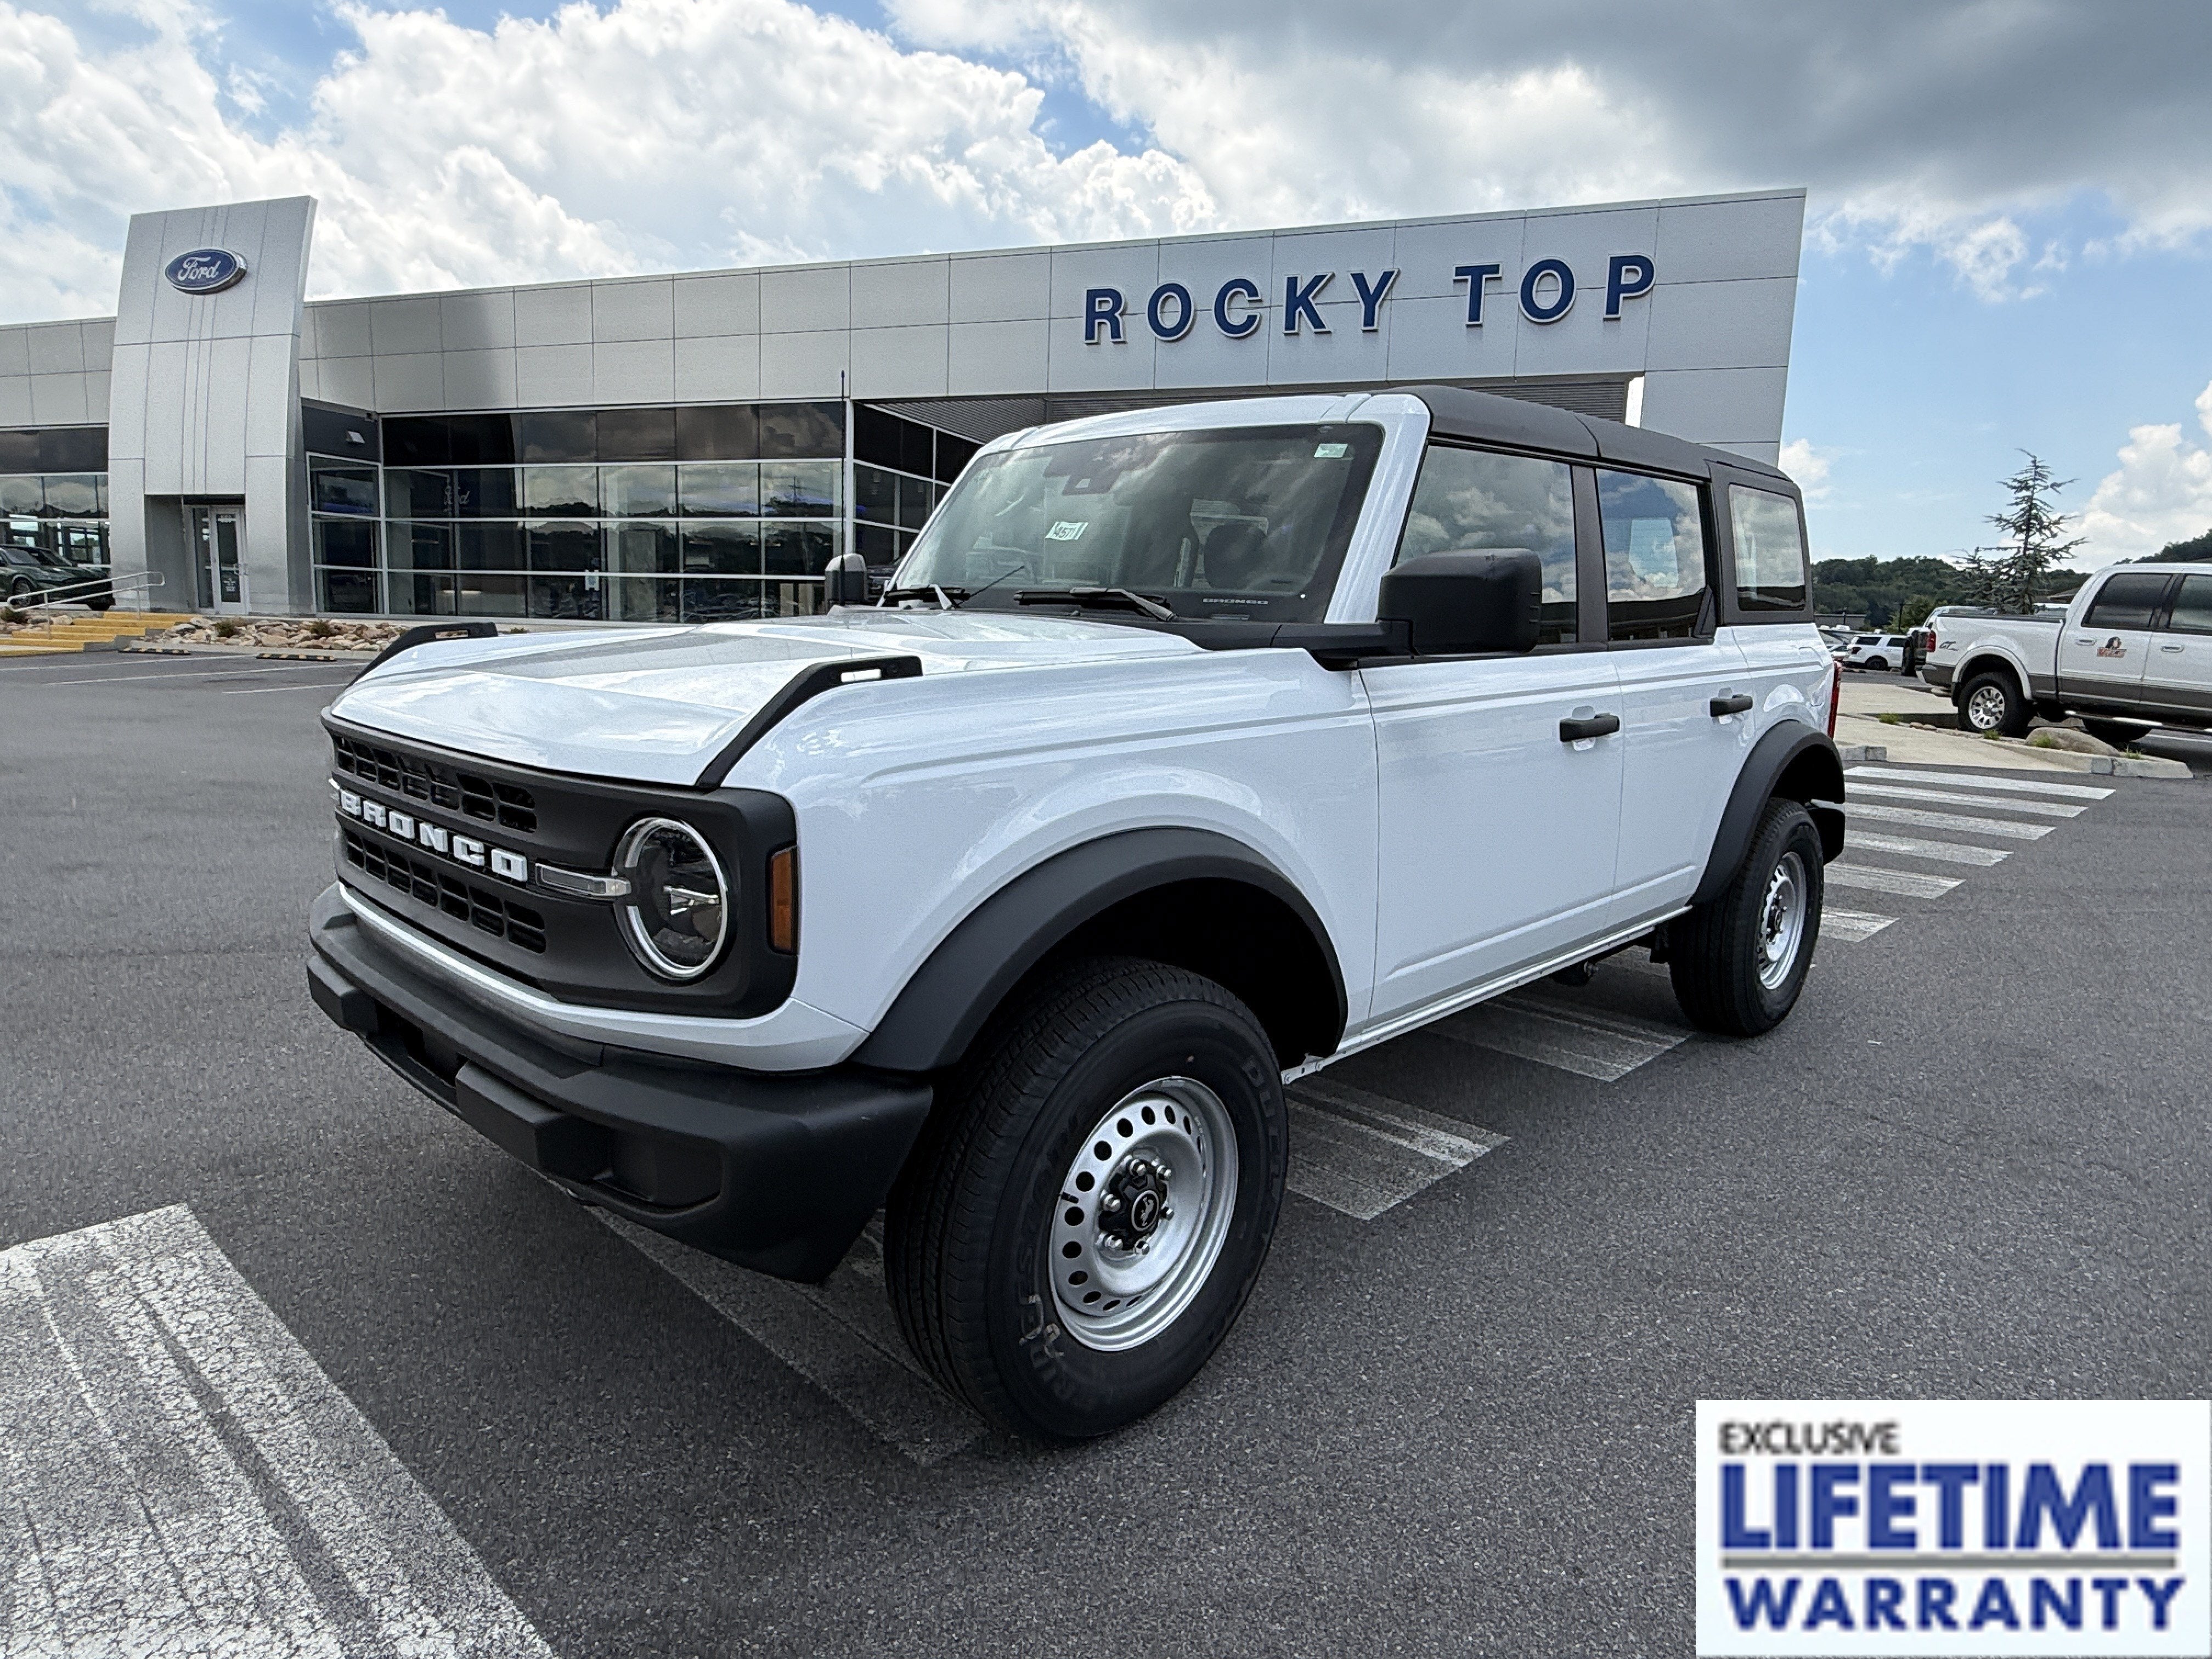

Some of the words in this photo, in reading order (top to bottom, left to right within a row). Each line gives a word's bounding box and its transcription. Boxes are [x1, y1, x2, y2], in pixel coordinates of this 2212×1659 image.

[178, 257, 222, 281] Ford
[1084, 268, 1399, 344] ROCKY
[1453, 252, 1656, 328] TOP
[340, 789, 528, 882] BRONCO
